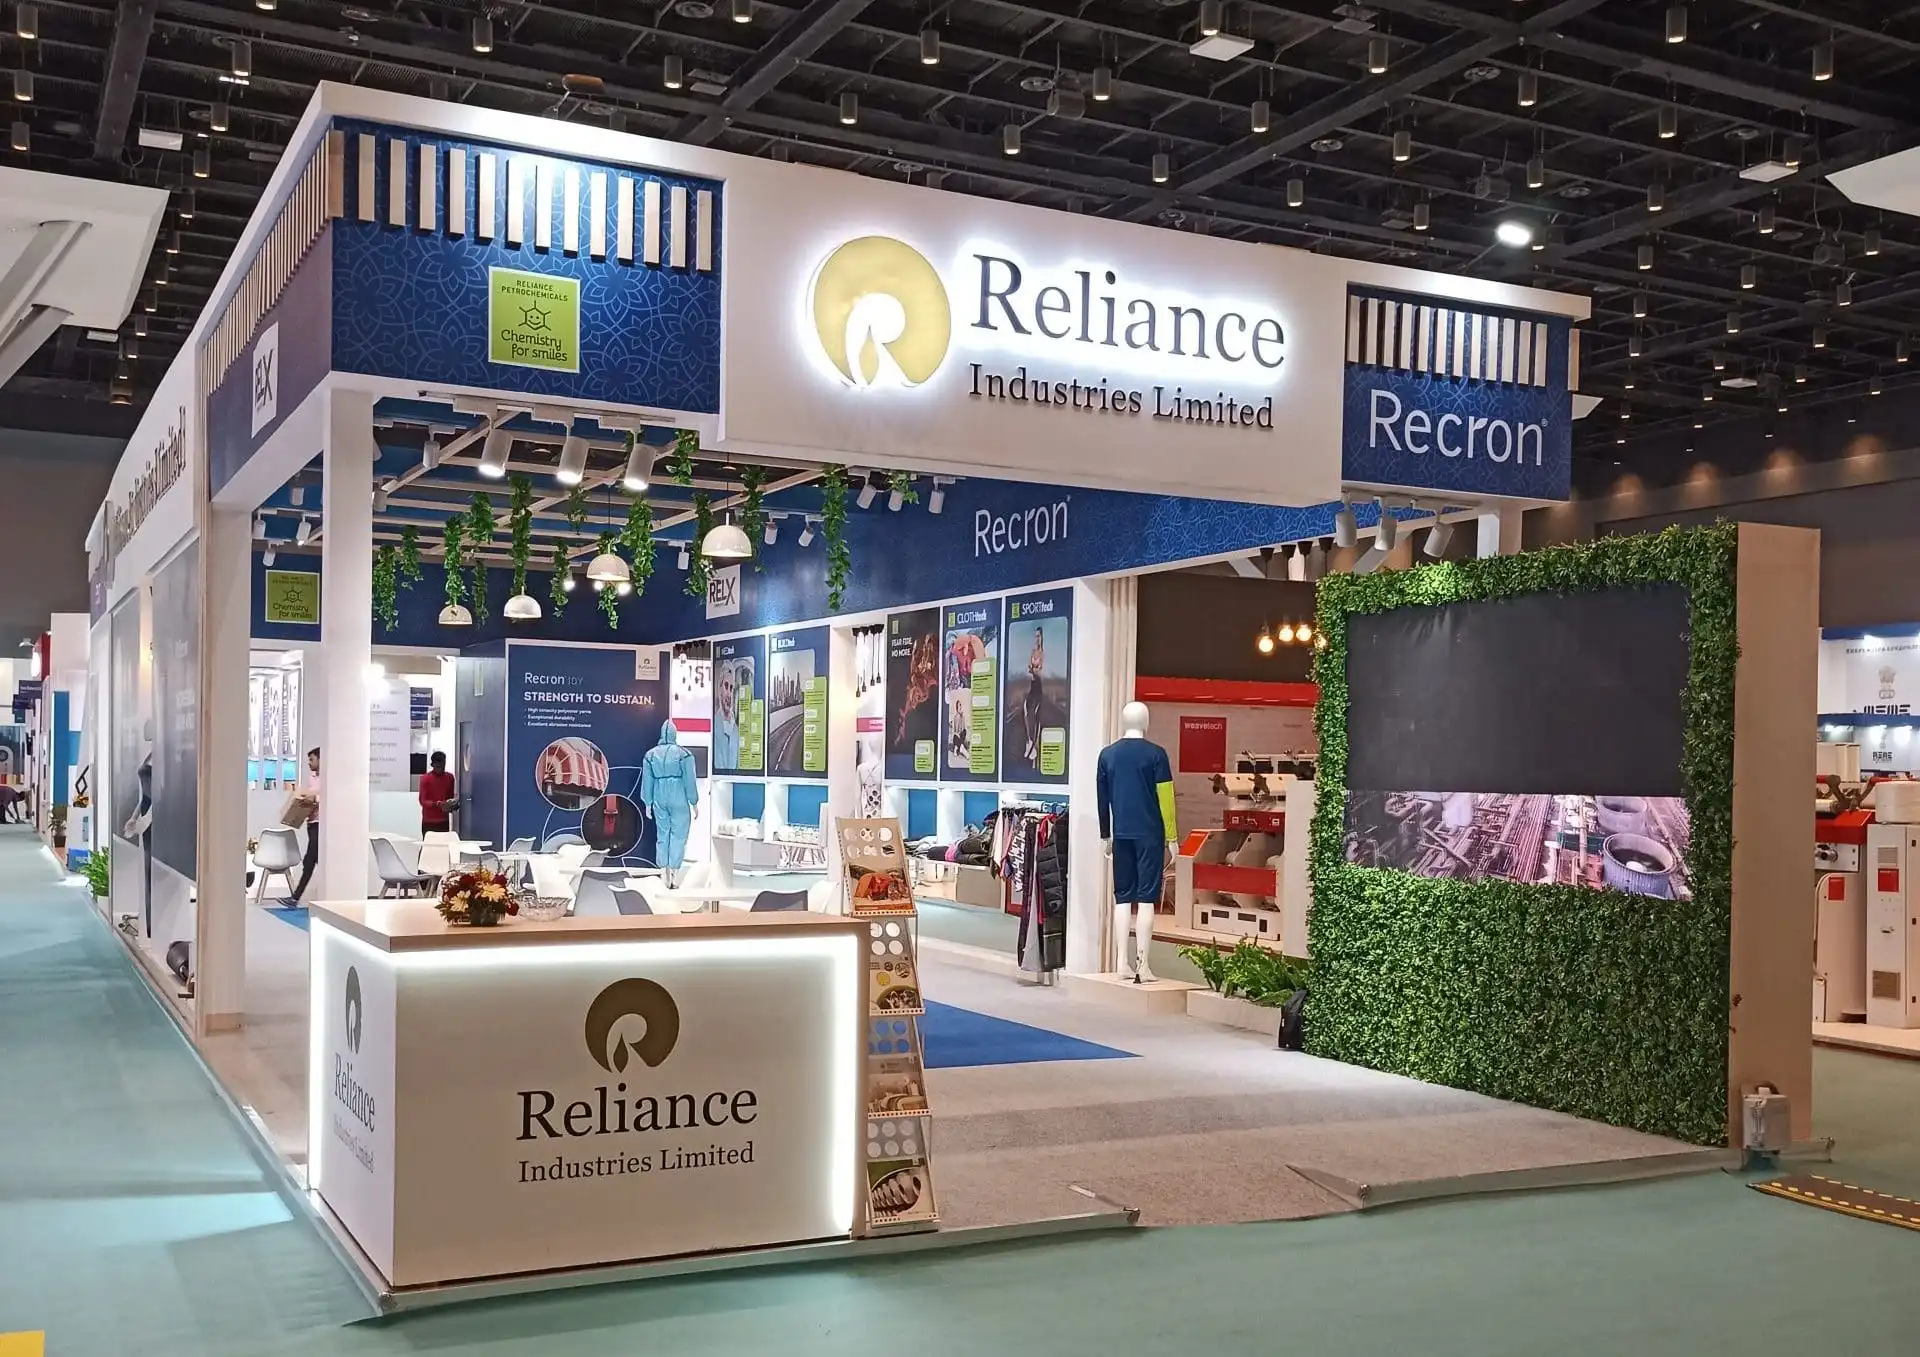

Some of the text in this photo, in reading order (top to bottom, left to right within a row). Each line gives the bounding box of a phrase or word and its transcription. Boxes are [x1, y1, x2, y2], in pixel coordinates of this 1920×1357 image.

[501, 285, 568, 302] PETROCHEMICALS
[516, 279, 553, 292] RELIANCE
[971, 253, 1285, 369] Reliance
[501, 329, 561, 351] Chemistry
[511, 343, 568, 362] for smiles
[969, 363, 1275, 430] Industries Limited
[709, 576, 736, 606] RELX
[1022, 599, 1054, 616] SPORTtech
[524, 672, 565, 685] Recron
[524, 691, 655, 706] STRENGTH TO SUSTAIN.
[335, 1052, 375, 1133] Reliance
[516, 1082, 758, 1141] Reliance
[518, 1141, 755, 1183] Industries Limited
